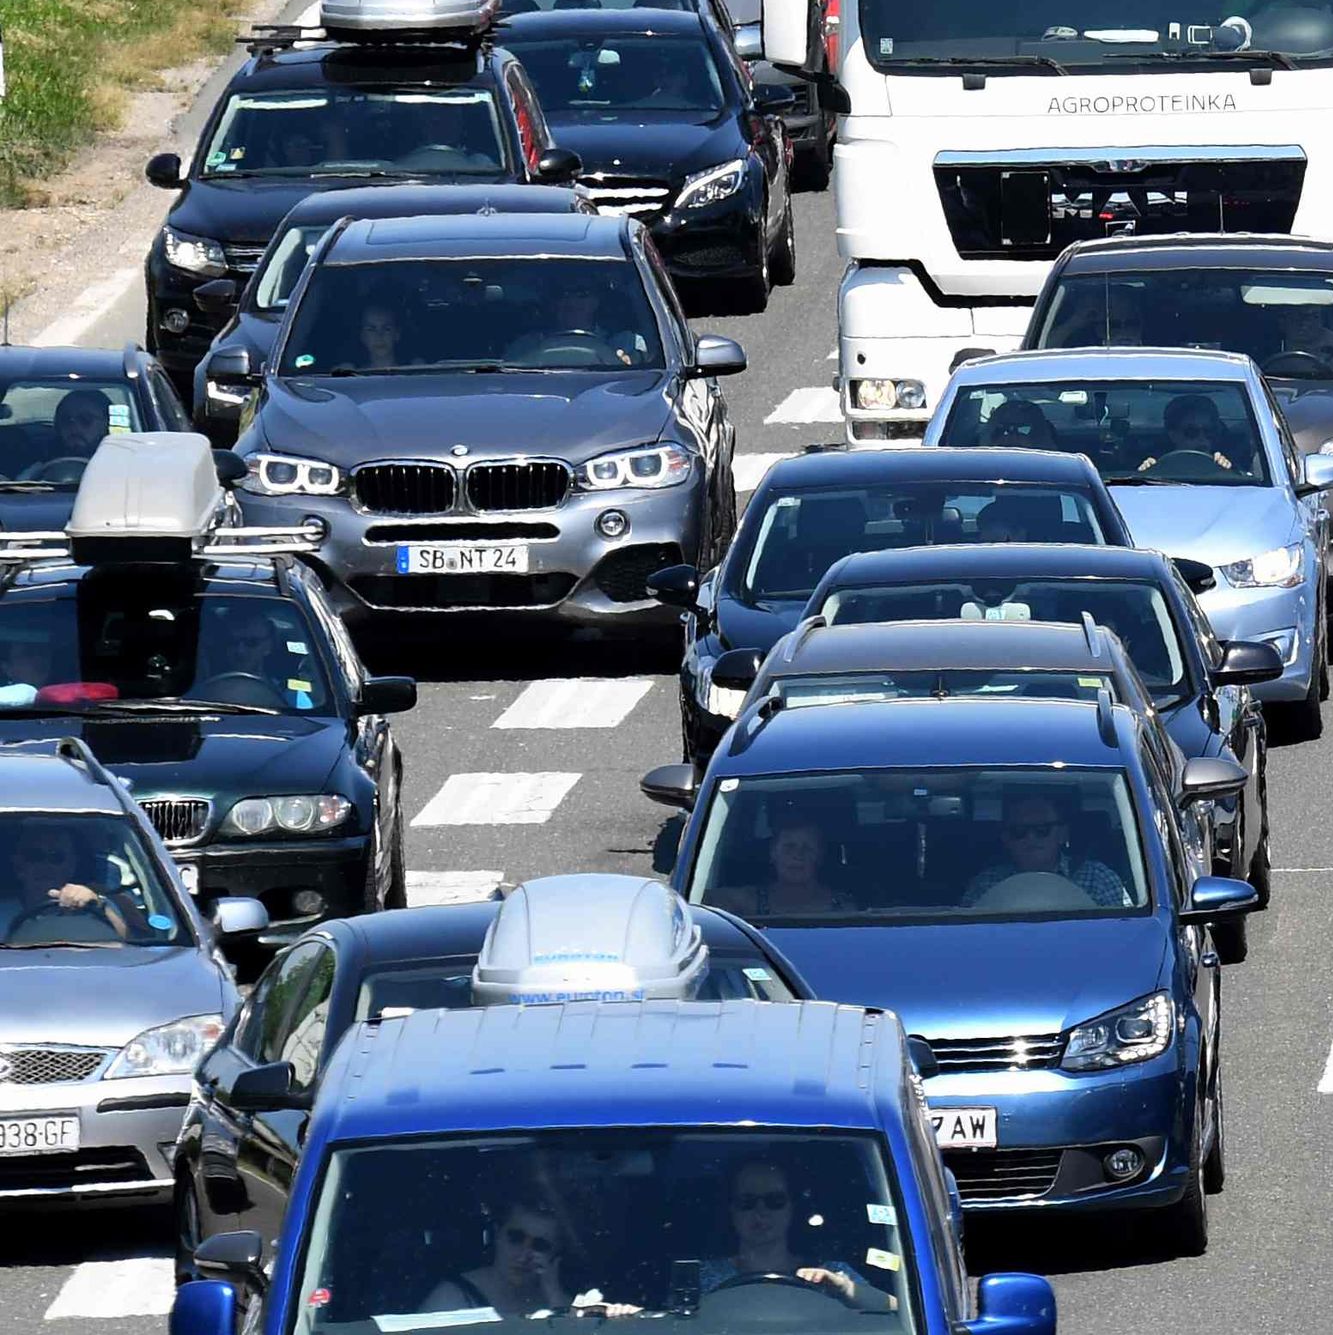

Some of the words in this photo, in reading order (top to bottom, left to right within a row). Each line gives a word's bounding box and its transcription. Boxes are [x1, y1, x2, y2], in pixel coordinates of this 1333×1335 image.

[1048, 94, 1237, 114] AGROPROTEINKA
[419, 549, 445, 569] SB
[460, 549, 486, 568] NT
[493, 548, 516, 567] 24
